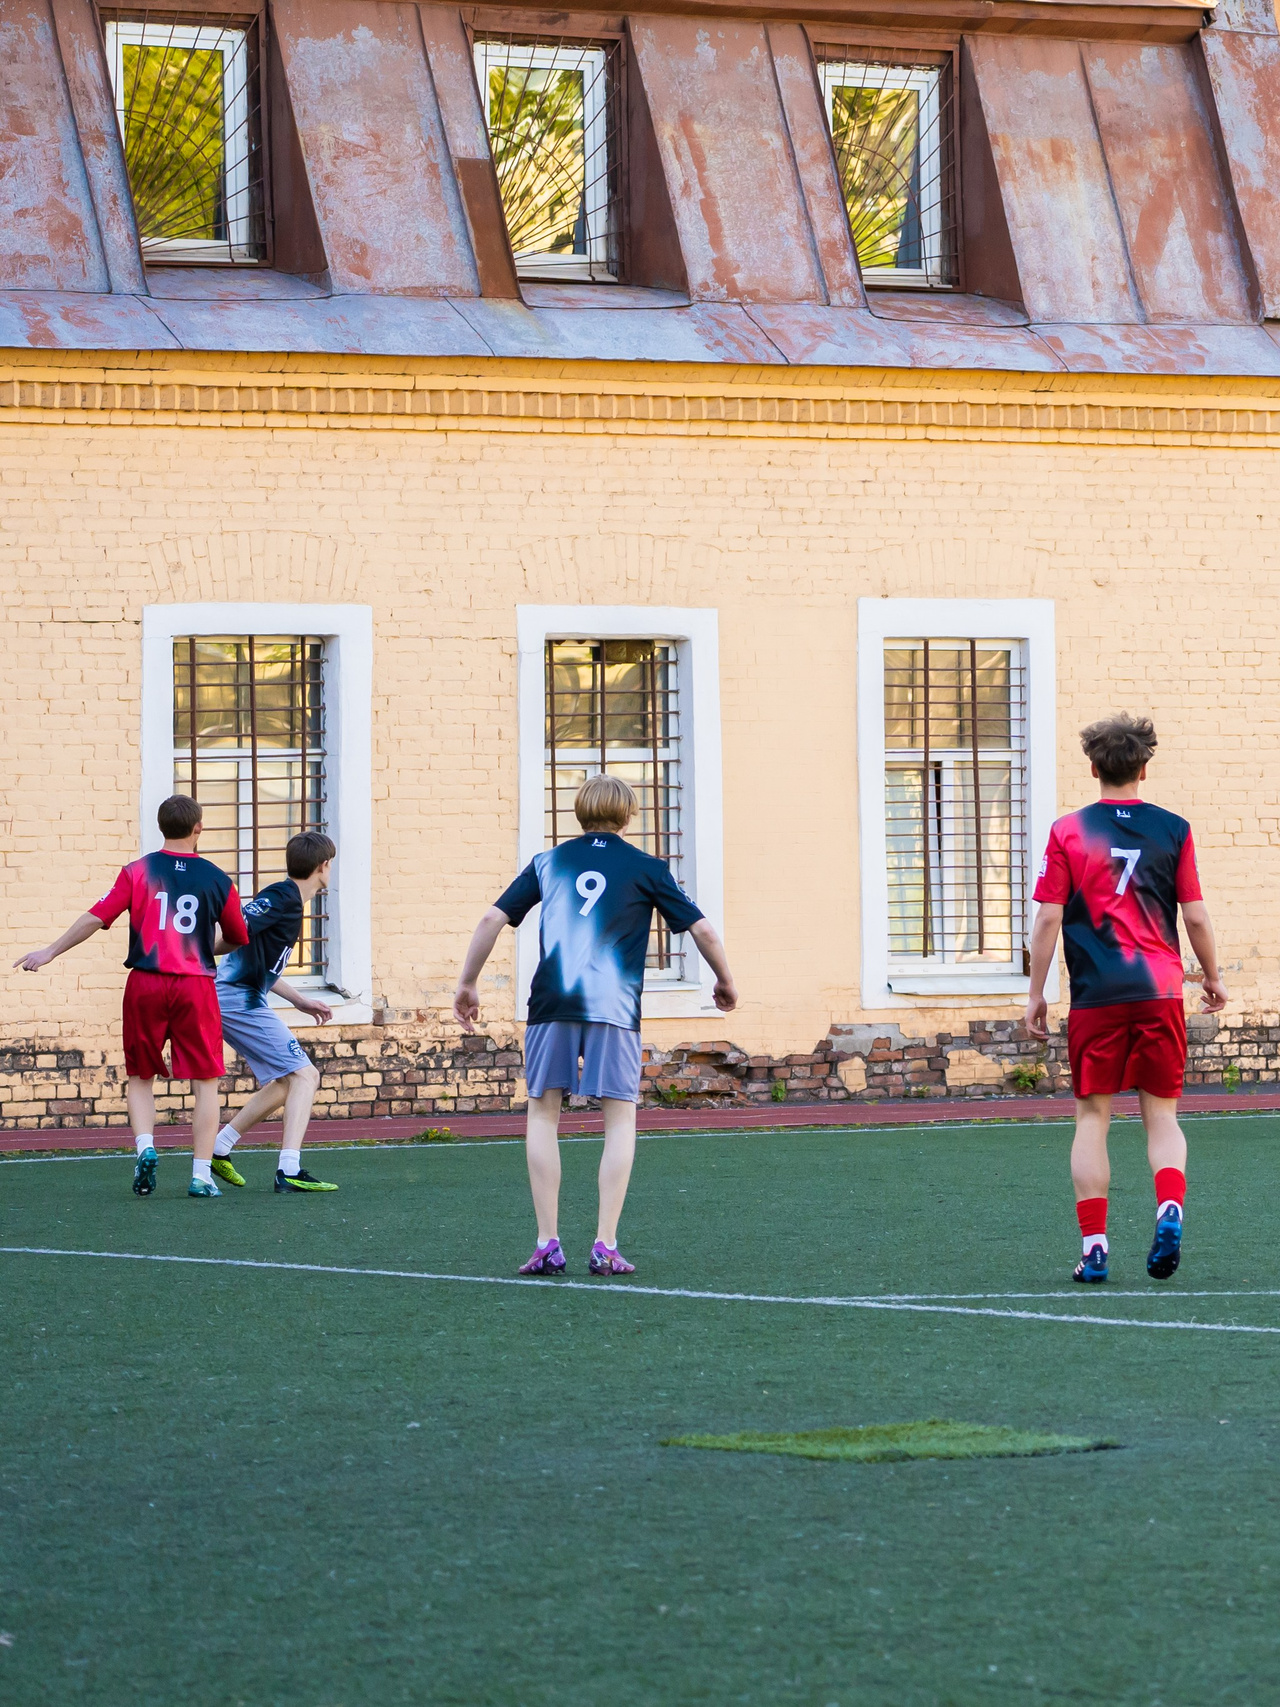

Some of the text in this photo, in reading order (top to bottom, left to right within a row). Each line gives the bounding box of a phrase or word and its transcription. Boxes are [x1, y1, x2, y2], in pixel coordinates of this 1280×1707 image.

[575, 870, 607, 917] 9
[1110, 847, 1141, 896] 7
[154, 891, 199, 934] 18
